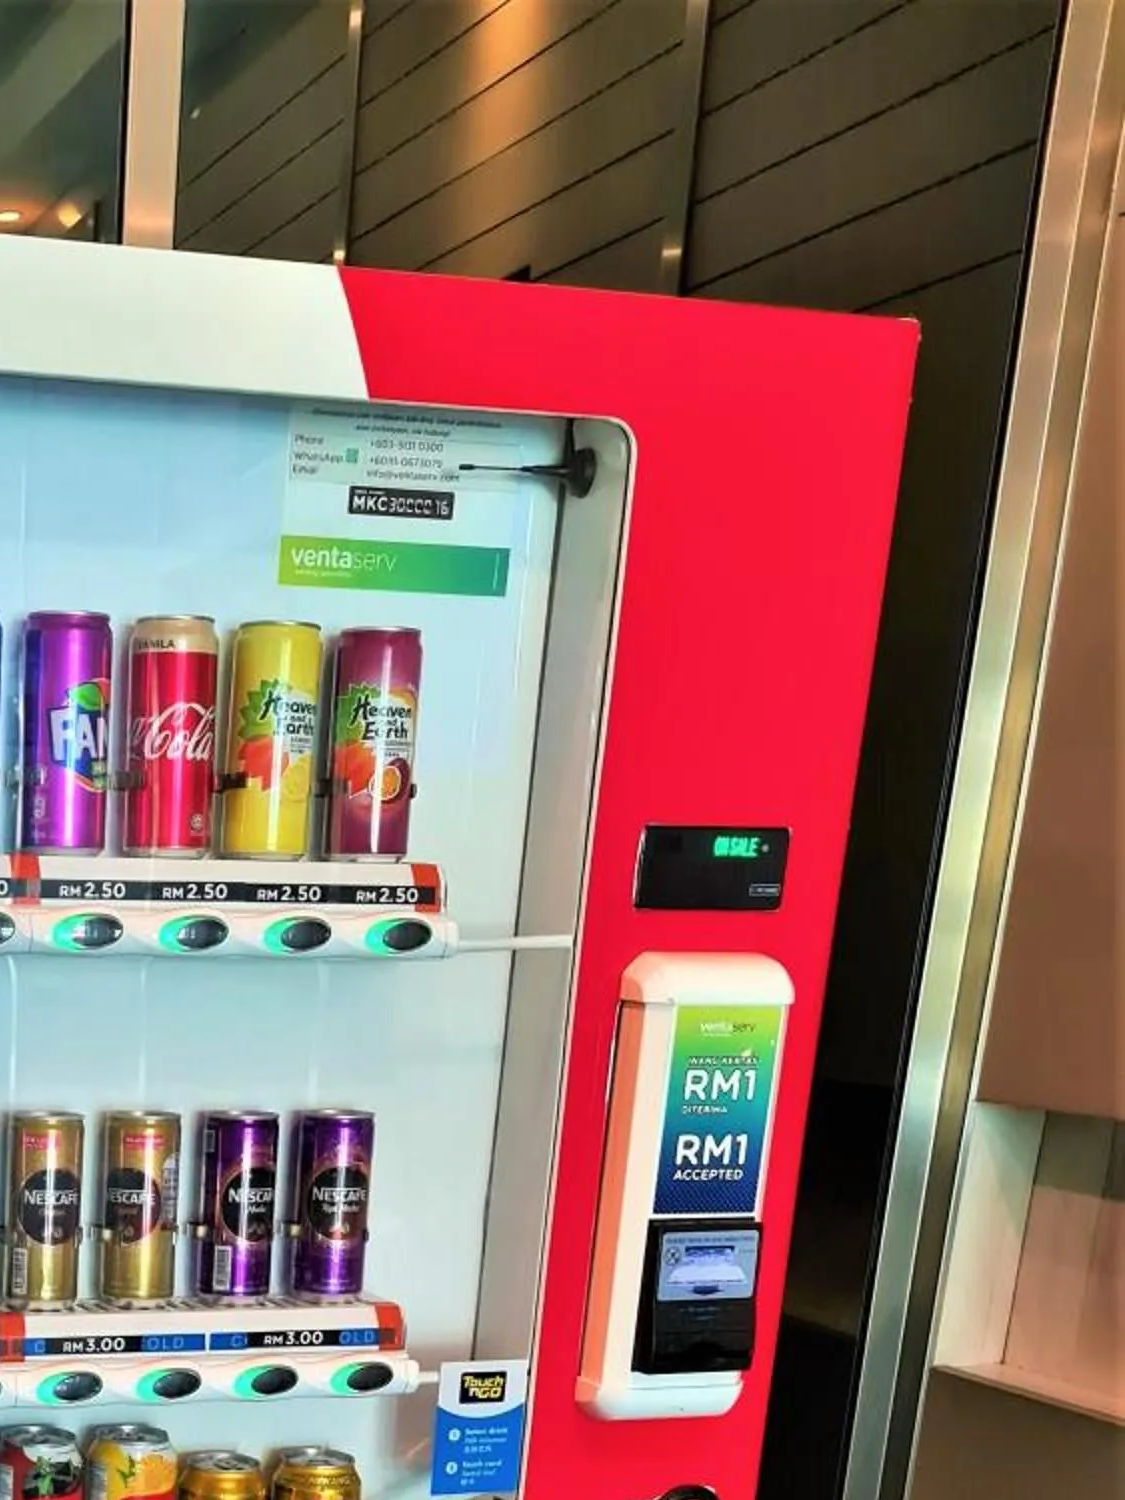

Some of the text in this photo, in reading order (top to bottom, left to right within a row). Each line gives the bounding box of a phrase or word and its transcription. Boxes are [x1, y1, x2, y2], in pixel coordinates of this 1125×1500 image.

[291, 546, 397, 572] ventaserv
[84, 882, 125, 899] 2.50
[186, 883, 228, 899] 2.50
[280, 886, 322, 901] 2.50
[378, 887, 419, 903] 2.50
[684, 1069, 756, 1101] RM1
[675, 1133, 748, 1166] RM1
[672, 1168, 744, 1181] ACCEPTED
[86, 1337, 125, 1352] 3.00
[285, 1330, 324, 1346] 3.00
[462, 1375, 504, 1388] Touch
